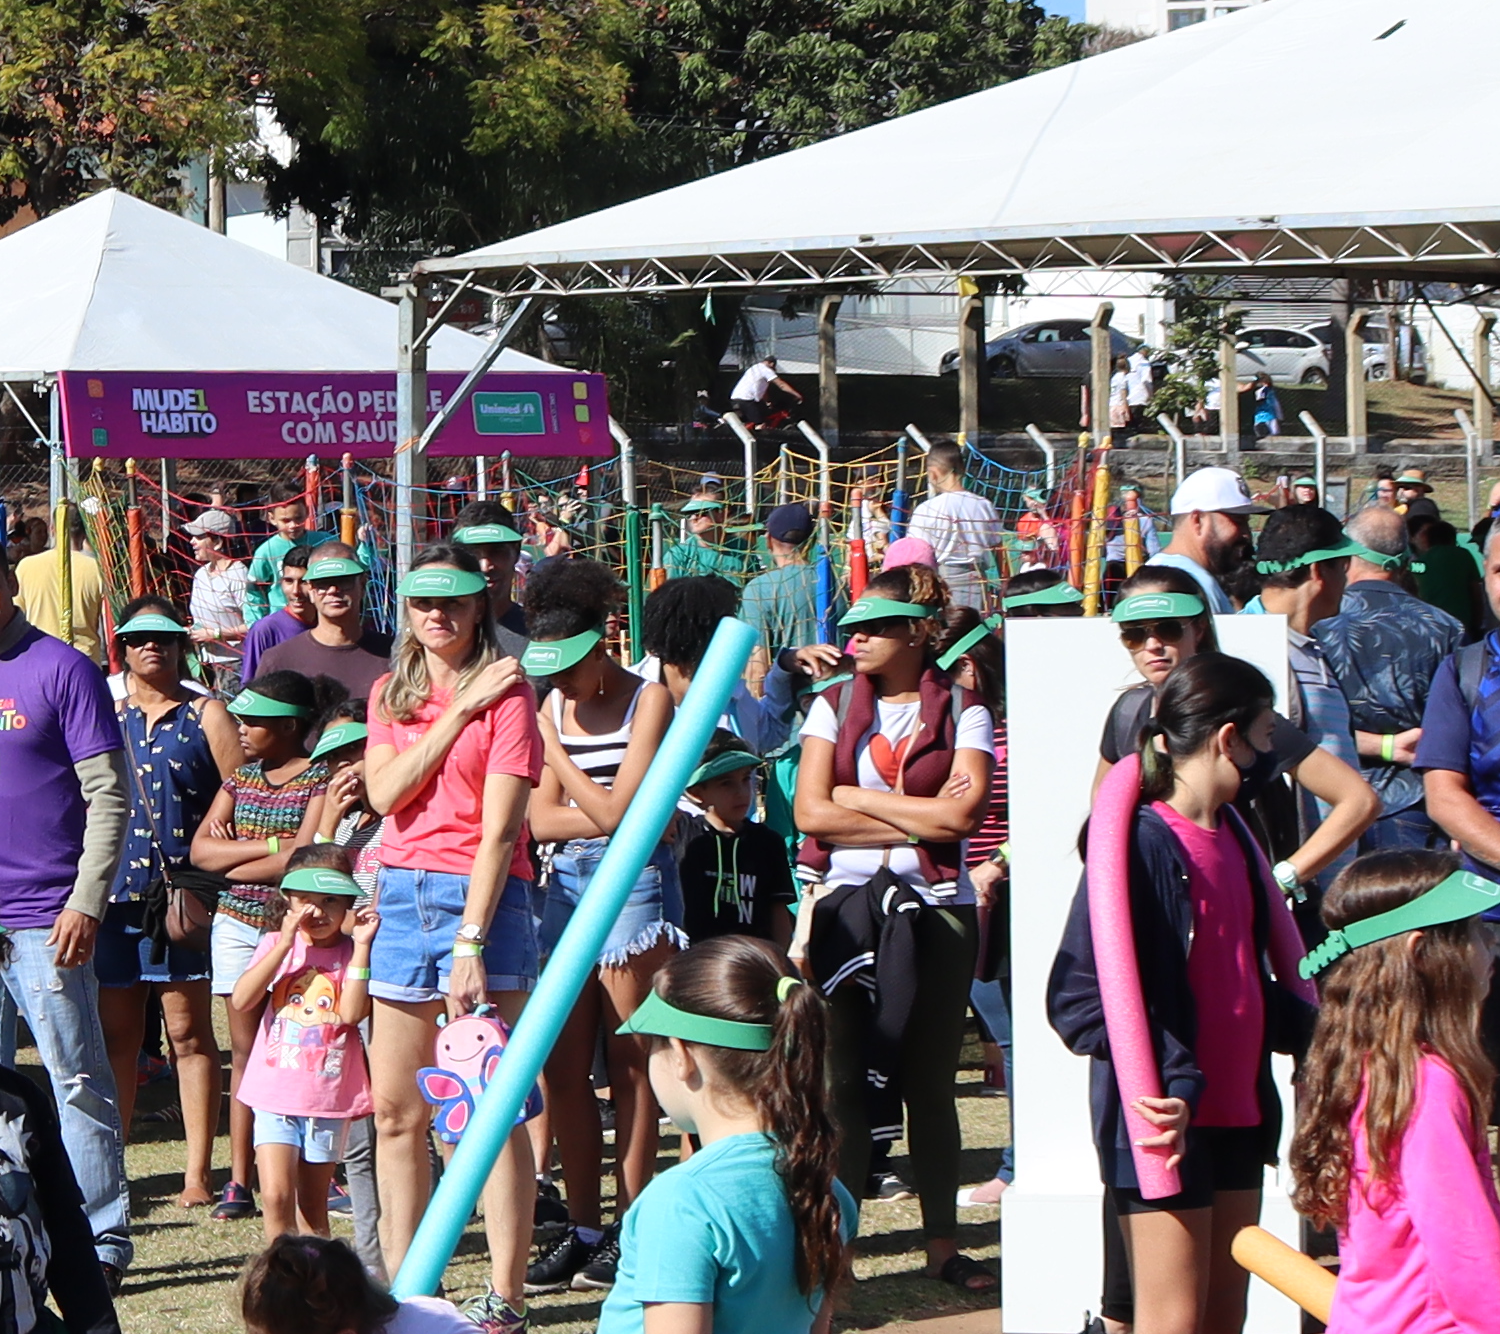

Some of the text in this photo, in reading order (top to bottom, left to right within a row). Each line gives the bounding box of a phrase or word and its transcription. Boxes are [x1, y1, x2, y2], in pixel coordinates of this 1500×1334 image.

[246, 385, 443, 421] ESTAÇÃO PEDE
[480, 402, 520, 415] Unimed
[281, 411, 398, 444] COM SAÚD
